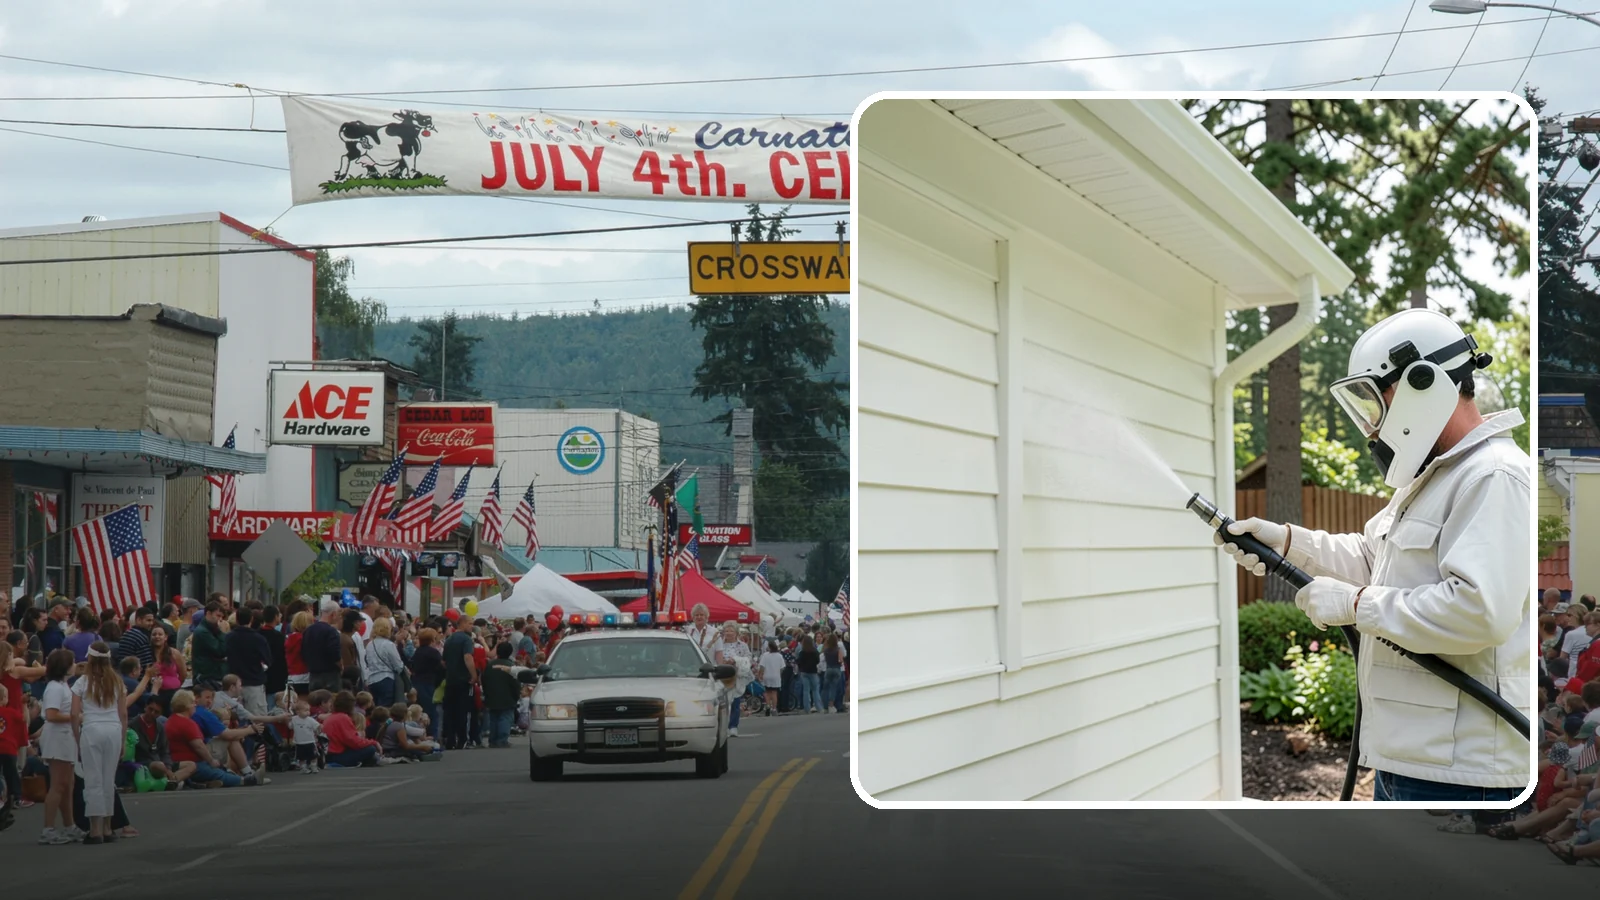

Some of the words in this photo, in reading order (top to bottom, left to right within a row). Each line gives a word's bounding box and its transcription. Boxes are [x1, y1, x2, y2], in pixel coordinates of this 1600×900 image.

[481, 141, 604, 192] JULY
[632, 149, 746, 197] 4th.
[697, 254, 850, 279] CROSSWA
[283, 380, 373, 420] ACE
[406, 409, 452, 421] CEDAR
[284, 421, 370, 436] Hardware
[416, 428, 476, 447] Coca-Cola
[354, 467, 383, 479] Simpl
[96, 485, 124, 495] Vincent
[126, 486, 136, 494] de
[138, 486, 155, 495] Paul
[688, 526, 741, 535] CRNATION
[699, 535, 730, 543] GLASS
